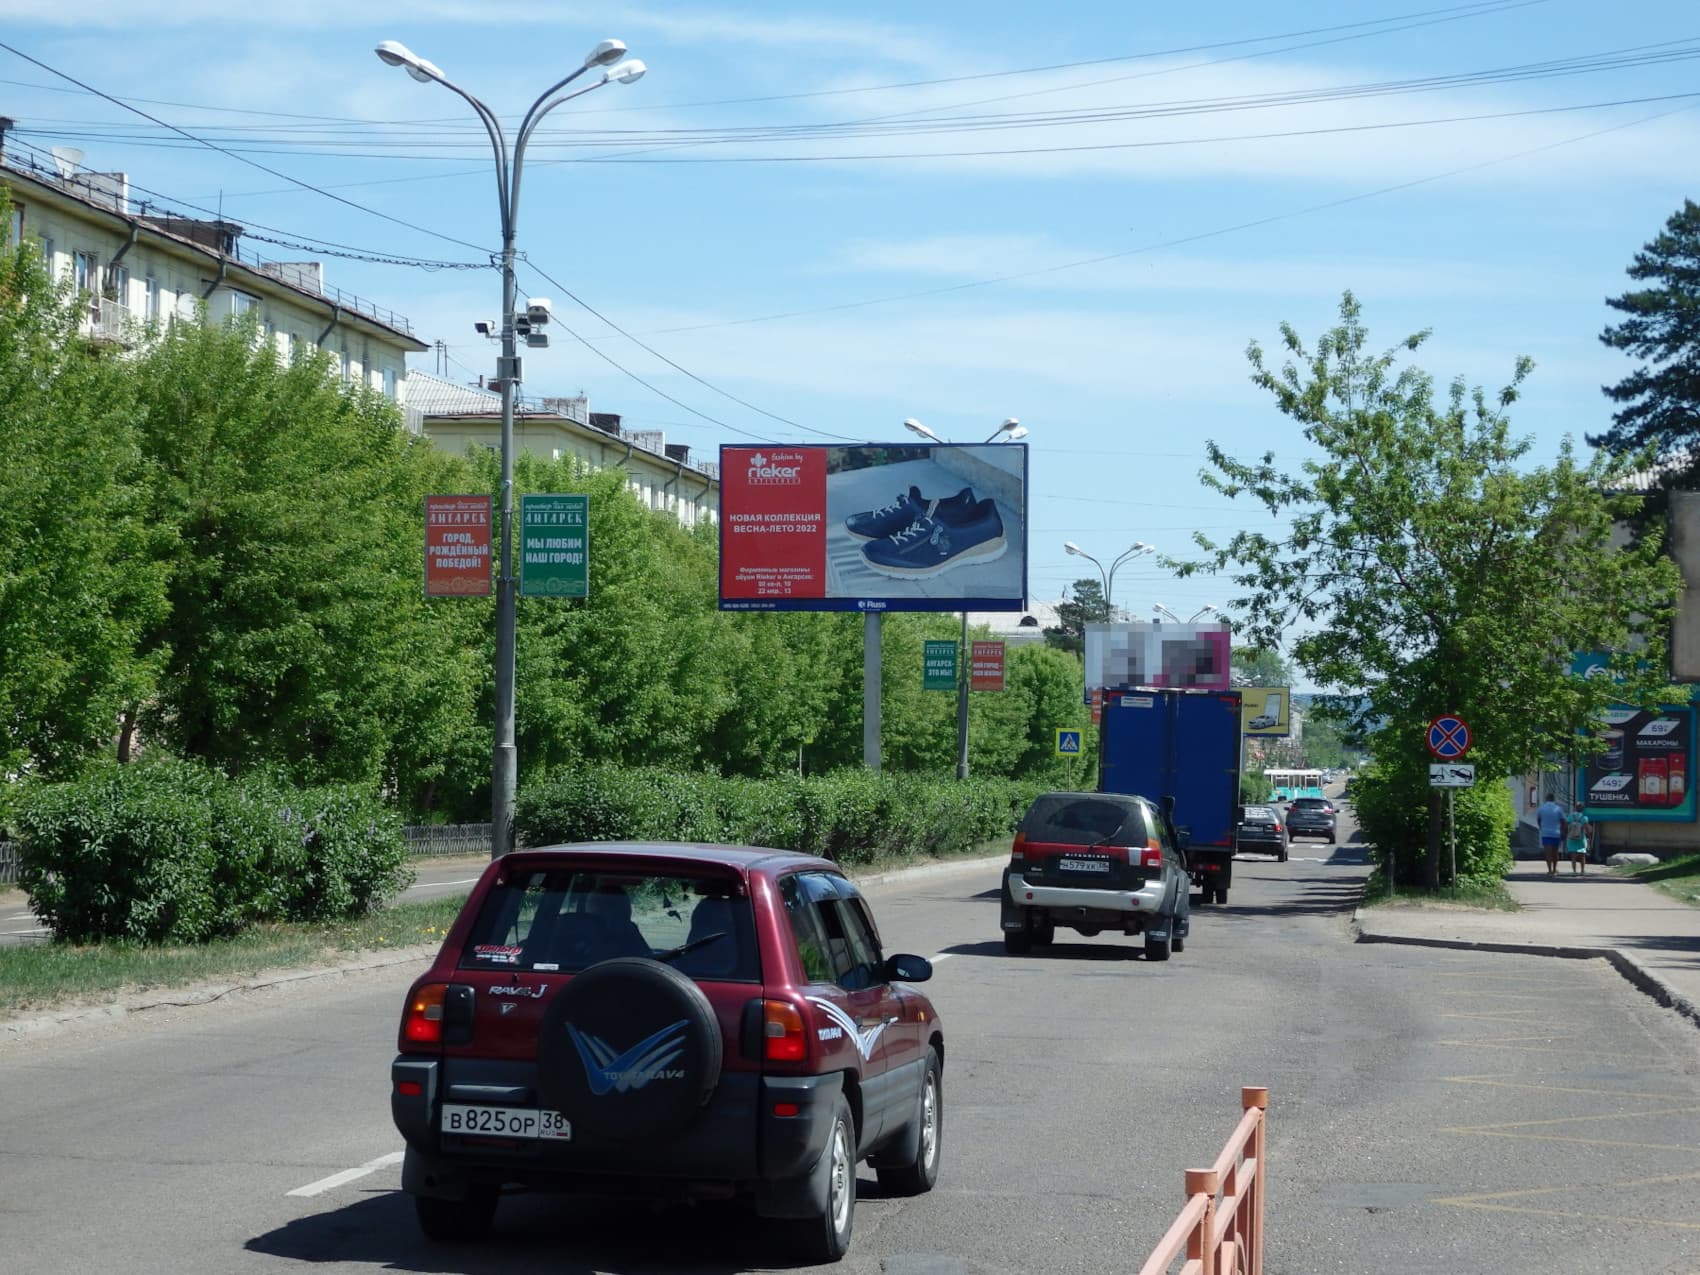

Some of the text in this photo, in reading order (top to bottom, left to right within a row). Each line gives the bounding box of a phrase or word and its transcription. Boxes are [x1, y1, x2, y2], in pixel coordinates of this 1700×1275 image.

[748, 463, 800, 478] rieker
[729, 513, 821, 523] НОВАЯ КОЛЛЕКЦИЯ
[733, 525, 795, 533] ВЕСНА-ЛЕТО
[442, 533, 475, 545] ГОРОД,
[527, 538, 582, 549] МЫ ЛЮБИМ
[436, 556, 481, 569] ПОБЕДОЙ!
[525, 552, 583, 565] НАШ ГОРОД!
[1636, 739, 1679, 747] МАКАРОНЫ
[1589, 793, 1630, 801] ТУШЕНКА
[543, 1112, 564, 1129] 38
